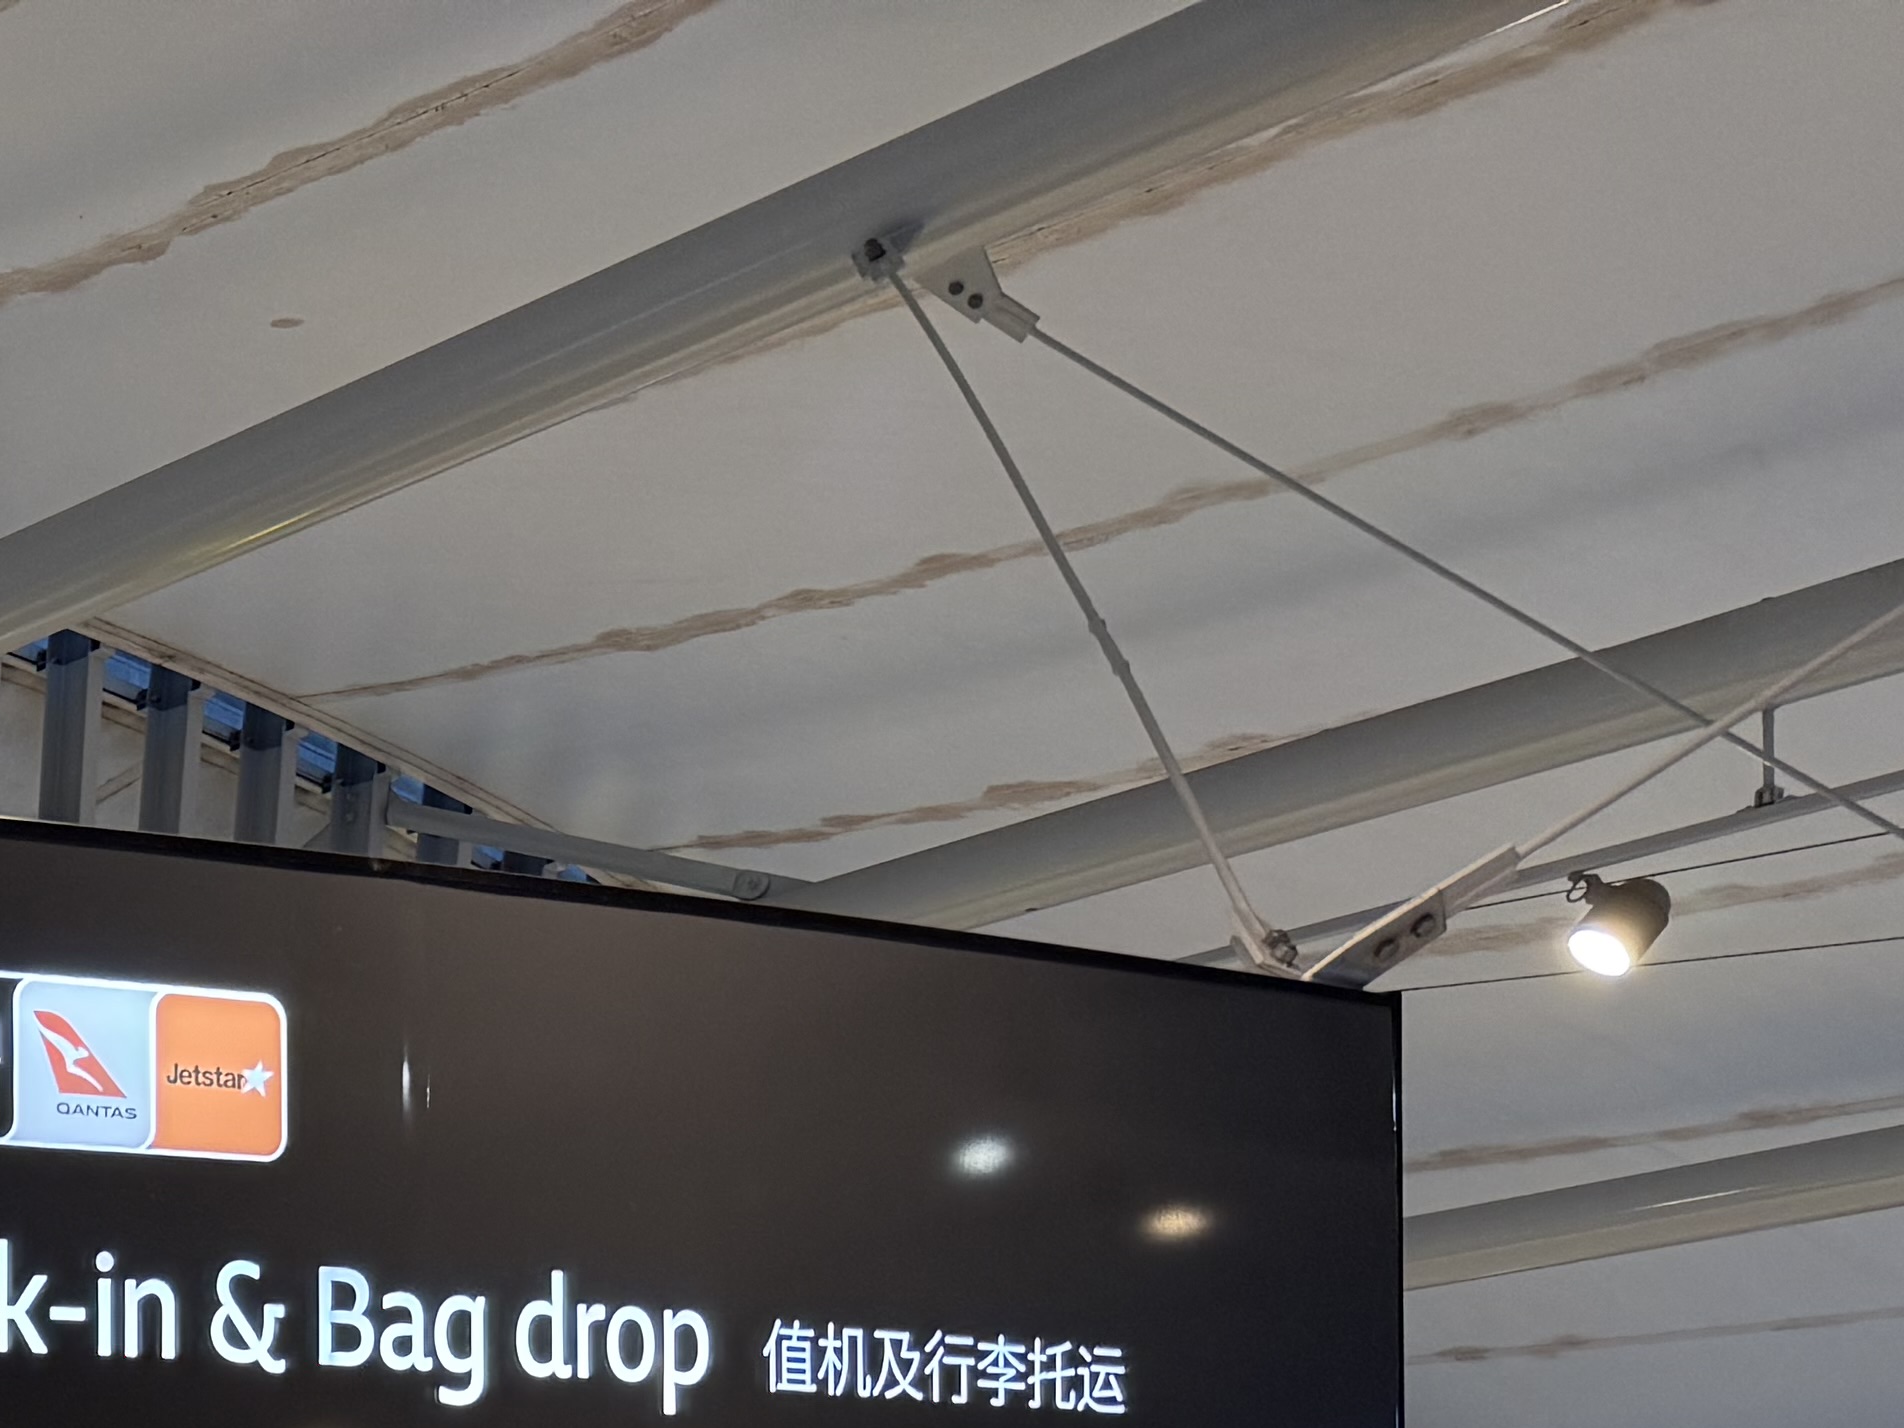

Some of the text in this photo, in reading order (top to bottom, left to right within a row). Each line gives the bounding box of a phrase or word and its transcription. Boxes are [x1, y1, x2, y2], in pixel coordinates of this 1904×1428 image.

[166, 1063, 245, 1090] Jetstar
[56, 1101, 137, 1120] QANTAS
[209, 1259, 288, 1375] &
[317, 1265, 489, 1407] Bag
[514, 1269, 714, 1416] drop
[762, 1318, 1127, 1415] 值机及行李托运
